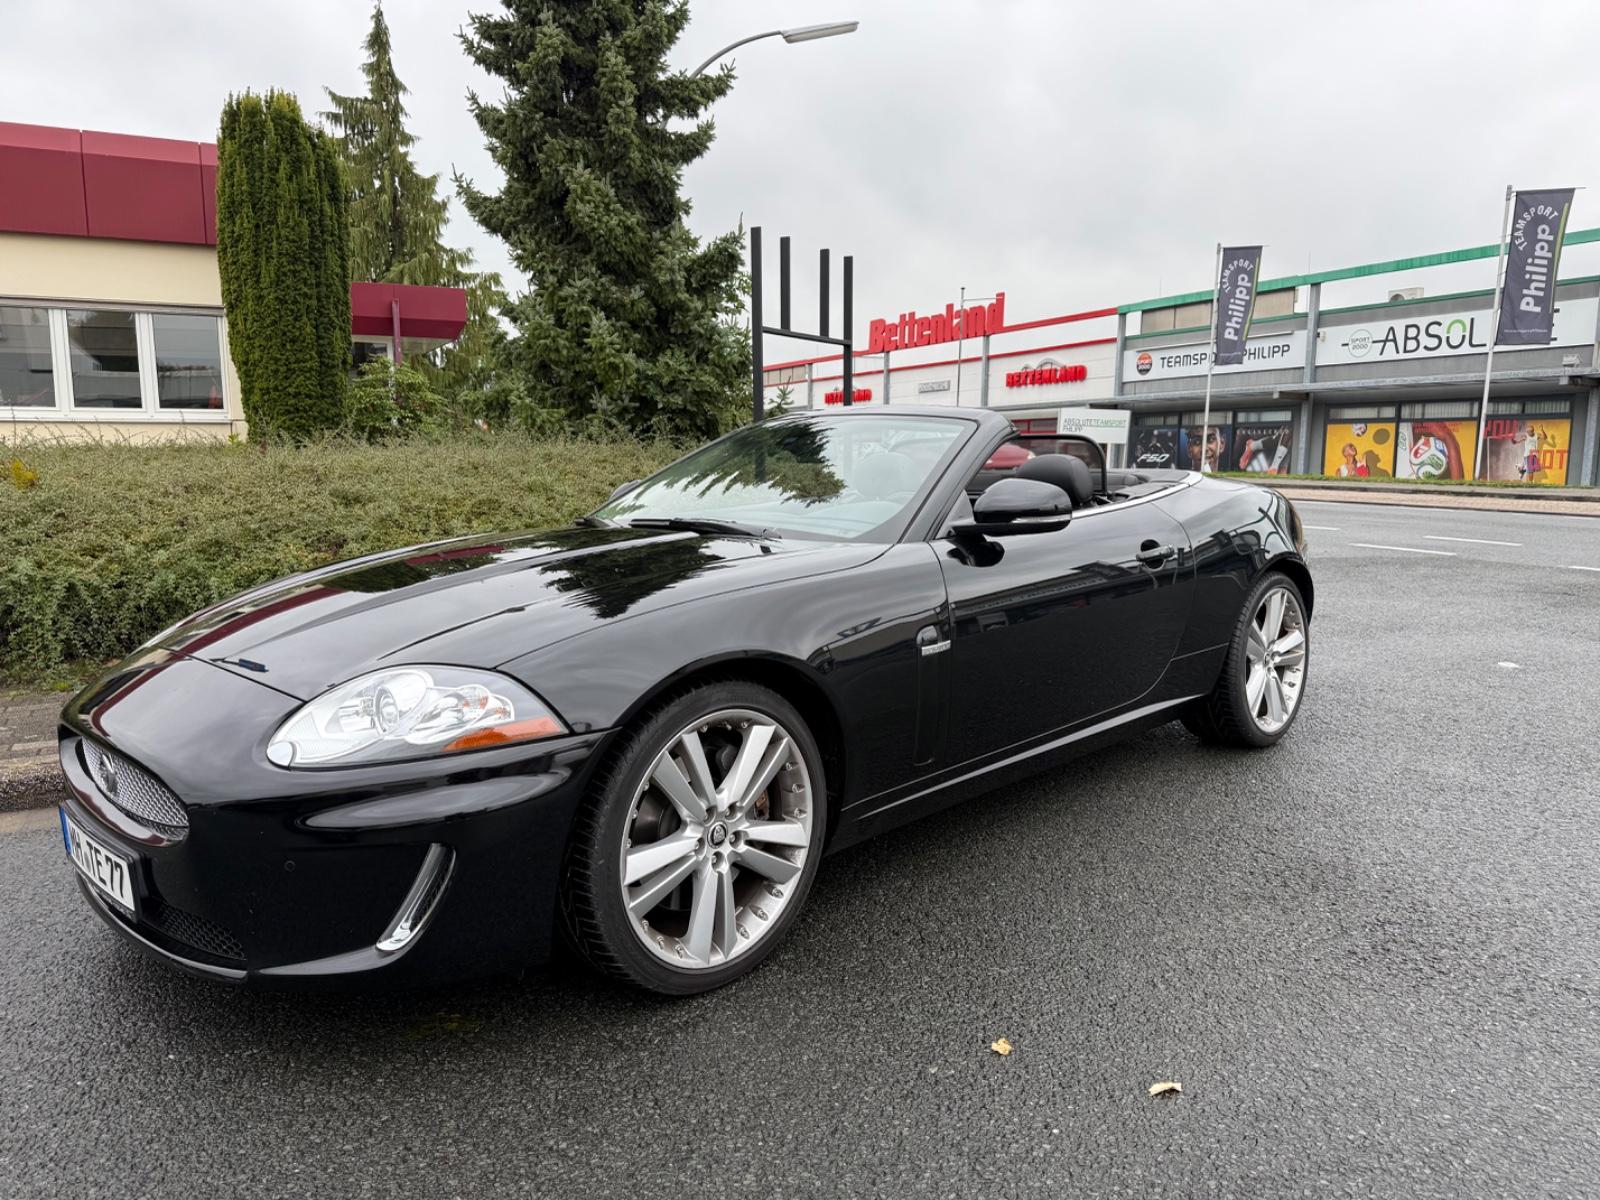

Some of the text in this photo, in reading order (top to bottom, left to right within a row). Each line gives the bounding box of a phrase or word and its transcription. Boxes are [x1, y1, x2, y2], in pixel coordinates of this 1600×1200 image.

[1513, 204, 1559, 251] TEAMSPORT
[1222, 258, 1254, 293] TEAMSPORT
[1519, 223, 1554, 313] Philipp
[868, 291, 1005, 352] Bettenland
[1224, 273, 1252, 341] Philipp
[1379, 317, 1487, 356] ABSOL
[1006, 365, 1087, 388] BETTENLAND
[1160, 352, 1216, 368] TEAMSPO
[1137, 453, 1170, 462] F50
